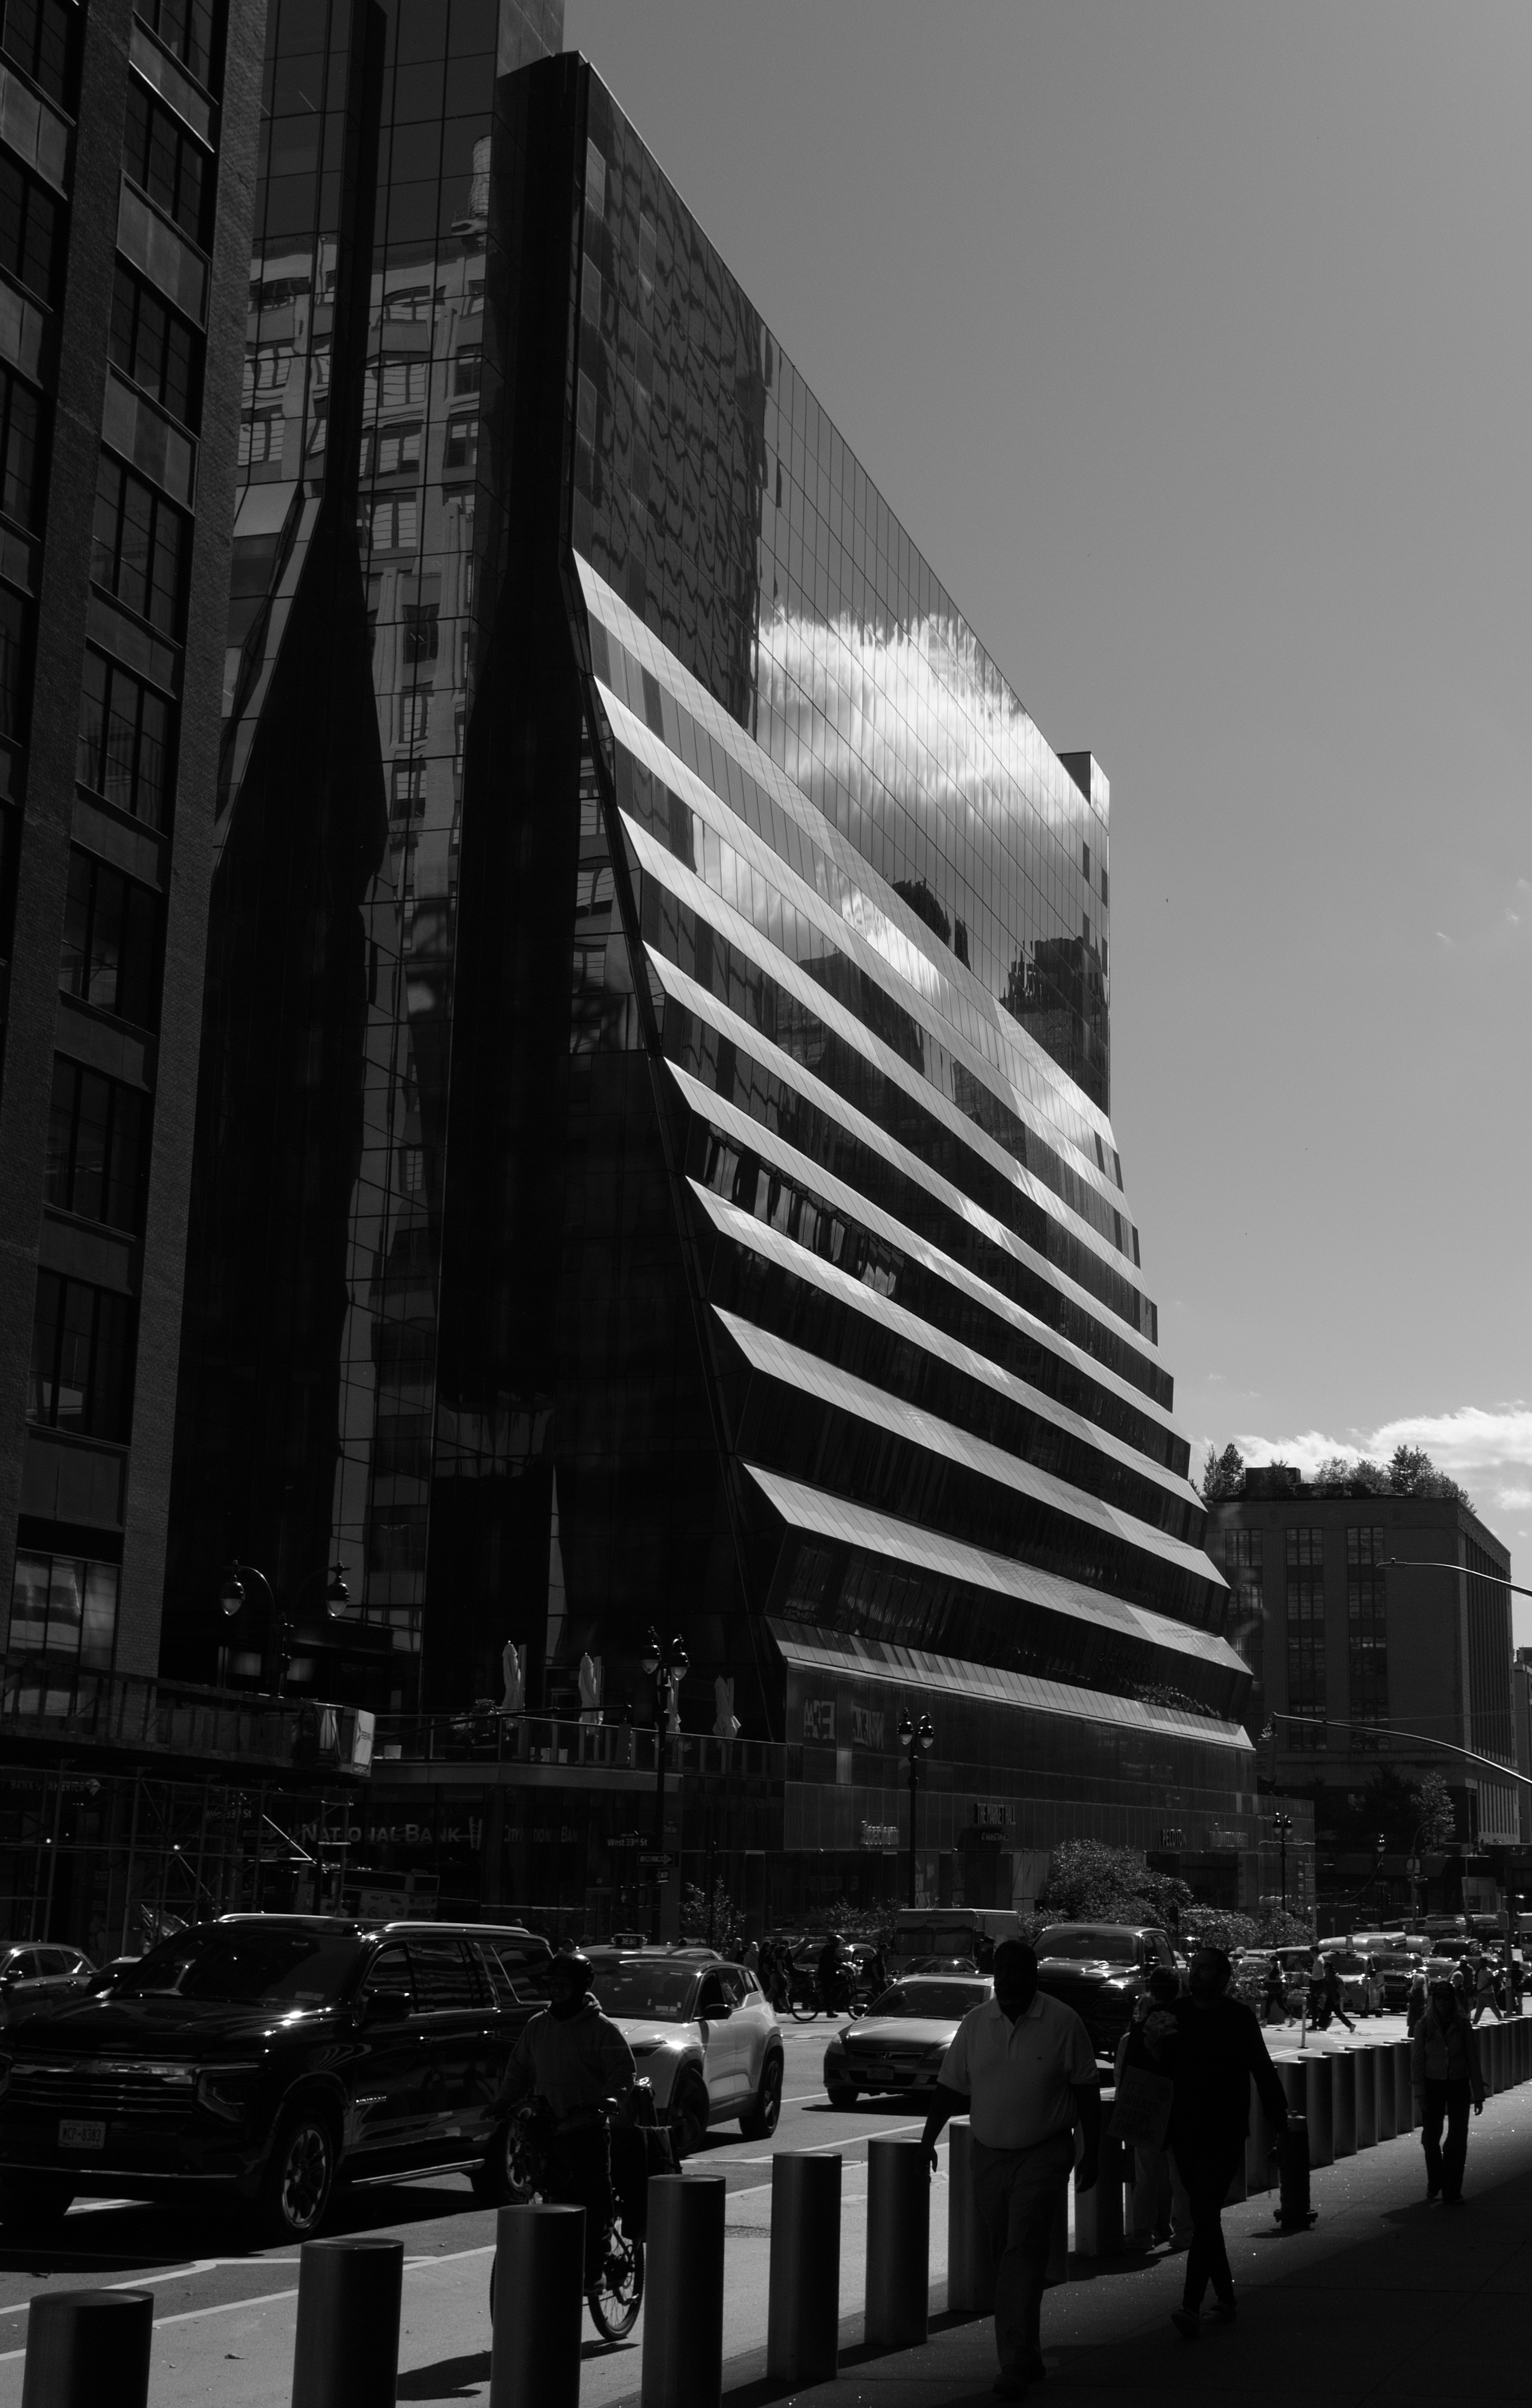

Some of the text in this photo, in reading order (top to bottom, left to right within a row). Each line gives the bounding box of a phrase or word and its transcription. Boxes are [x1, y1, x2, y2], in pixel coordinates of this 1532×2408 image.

[977, 1803, 1016, 1825] THE MARKET HALL
[607, 1838, 625, 1846] West
[640, 1838, 648, 1846] St
[1162, 1828, 1187, 1847] PELOTON
[621, 1937, 637, 1945] 3E80
[1118, 2106, 1138, 2122] NOT
